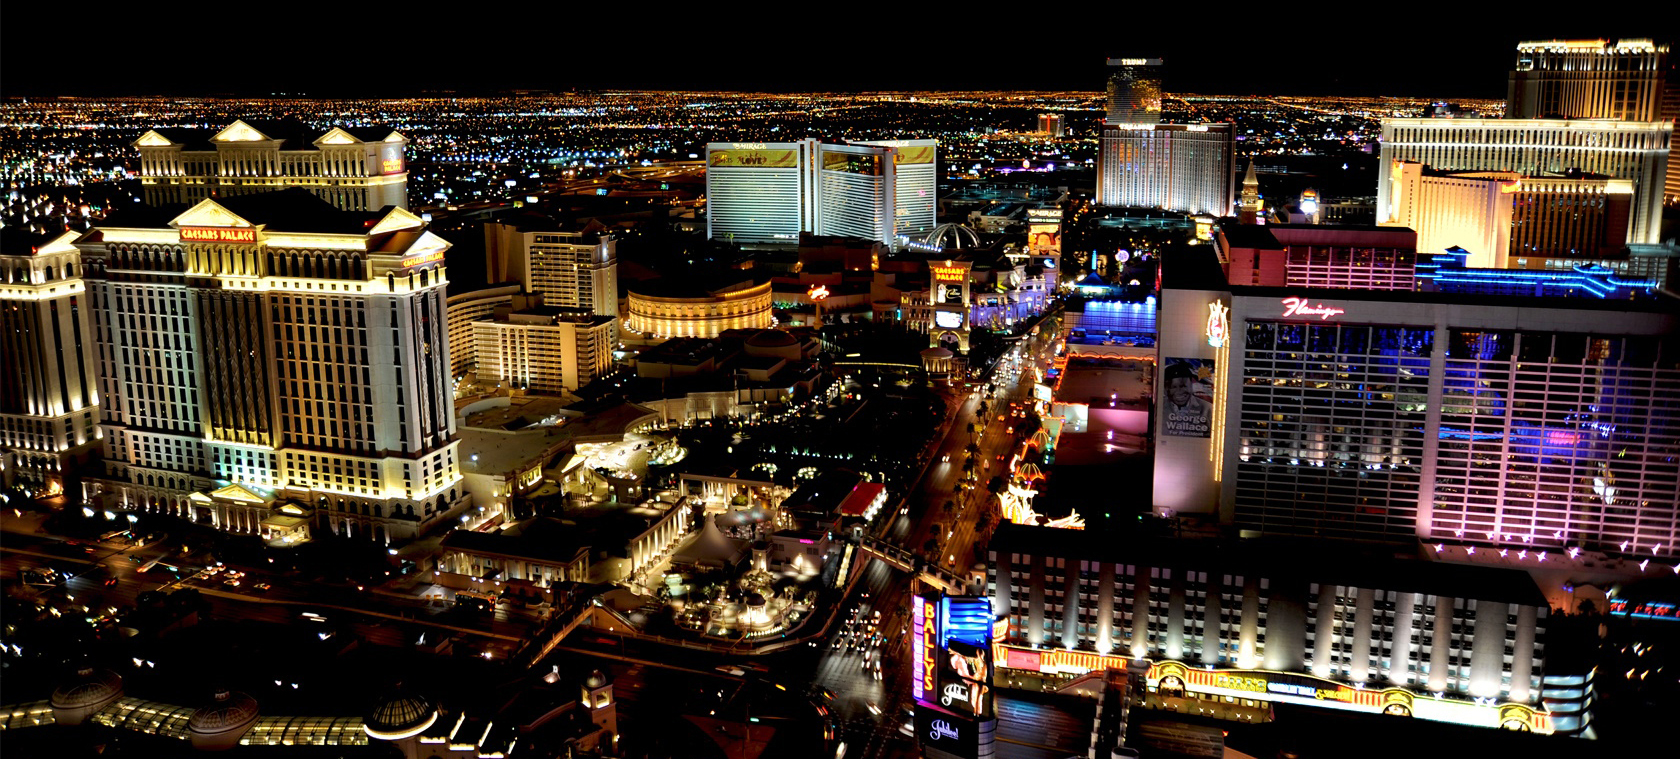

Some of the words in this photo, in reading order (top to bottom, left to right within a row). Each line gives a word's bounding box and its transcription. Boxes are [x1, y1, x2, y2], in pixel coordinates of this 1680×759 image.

[182, 229, 218, 239] CAESARS
[220, 230, 254, 241] PALACE
[935, 267, 964, 275] CAESARS
[1281, 297, 1344, 320] Flamingo
[1168, 413, 1207, 424] George
[1166, 421, 1208, 432] Wallace
